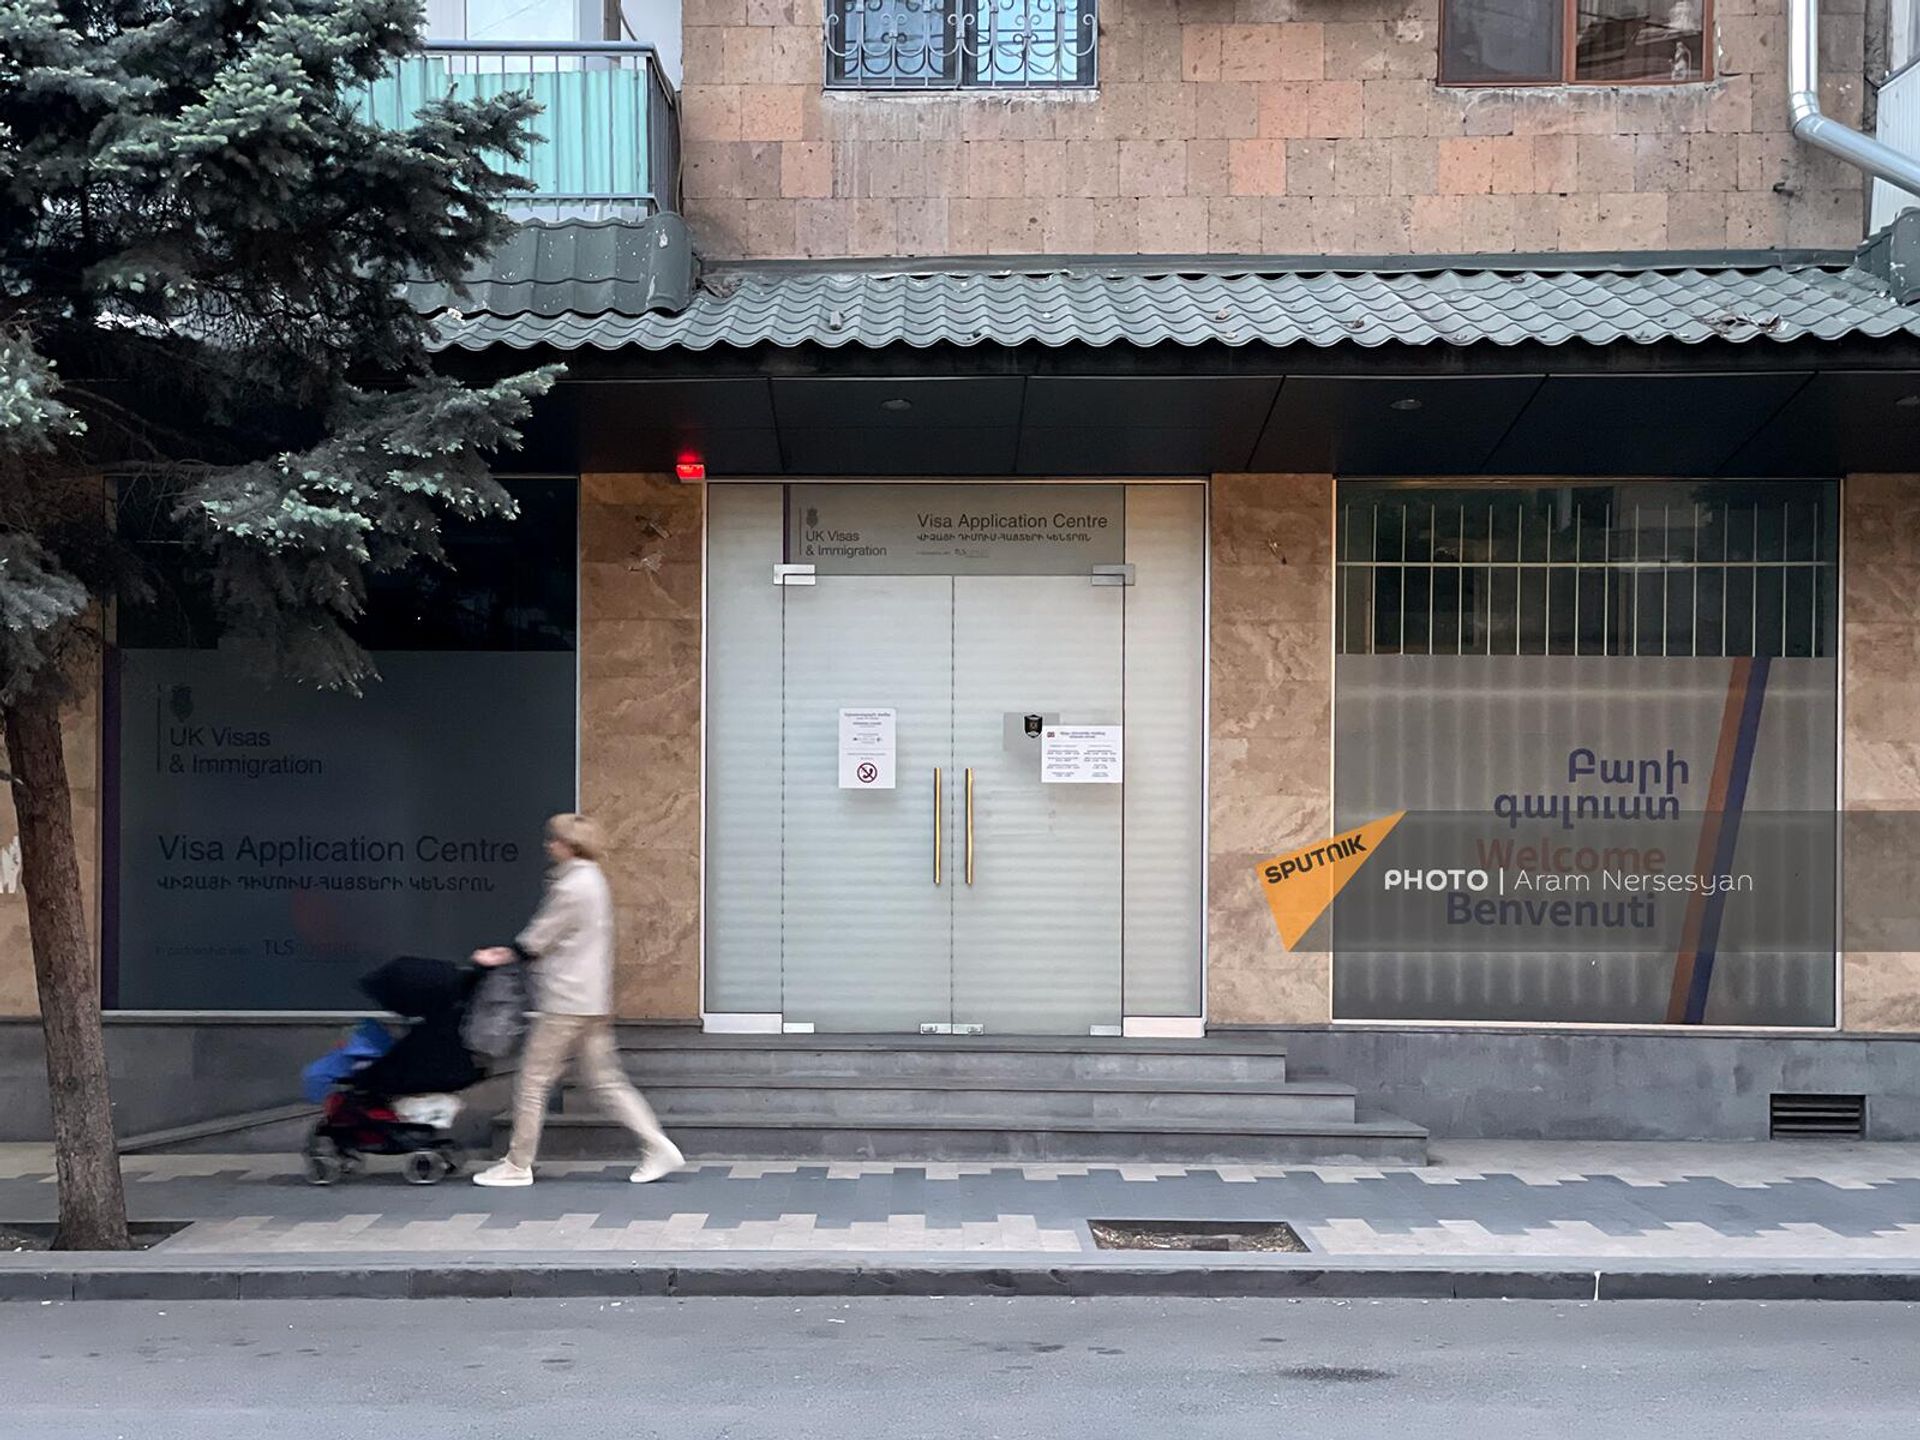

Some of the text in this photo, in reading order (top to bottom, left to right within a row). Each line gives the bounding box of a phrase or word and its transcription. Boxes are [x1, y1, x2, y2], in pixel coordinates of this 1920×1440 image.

[805, 530, 860, 543] UK Visas
[917, 513, 1108, 532] Visa Application Centre
[805, 545, 887, 559] & Immigration
[169, 728, 271, 748] UK Visas
[169, 754, 323, 779] & Immigration
[1568, 748, 1689, 794] Բարի
[1494, 794, 1680, 829] գալուստ
[158, 835, 519, 868] Visa Application Centre
[1476, 838, 1666, 873] Welcome
[1448, 892, 1655, 928] Benvenuti
